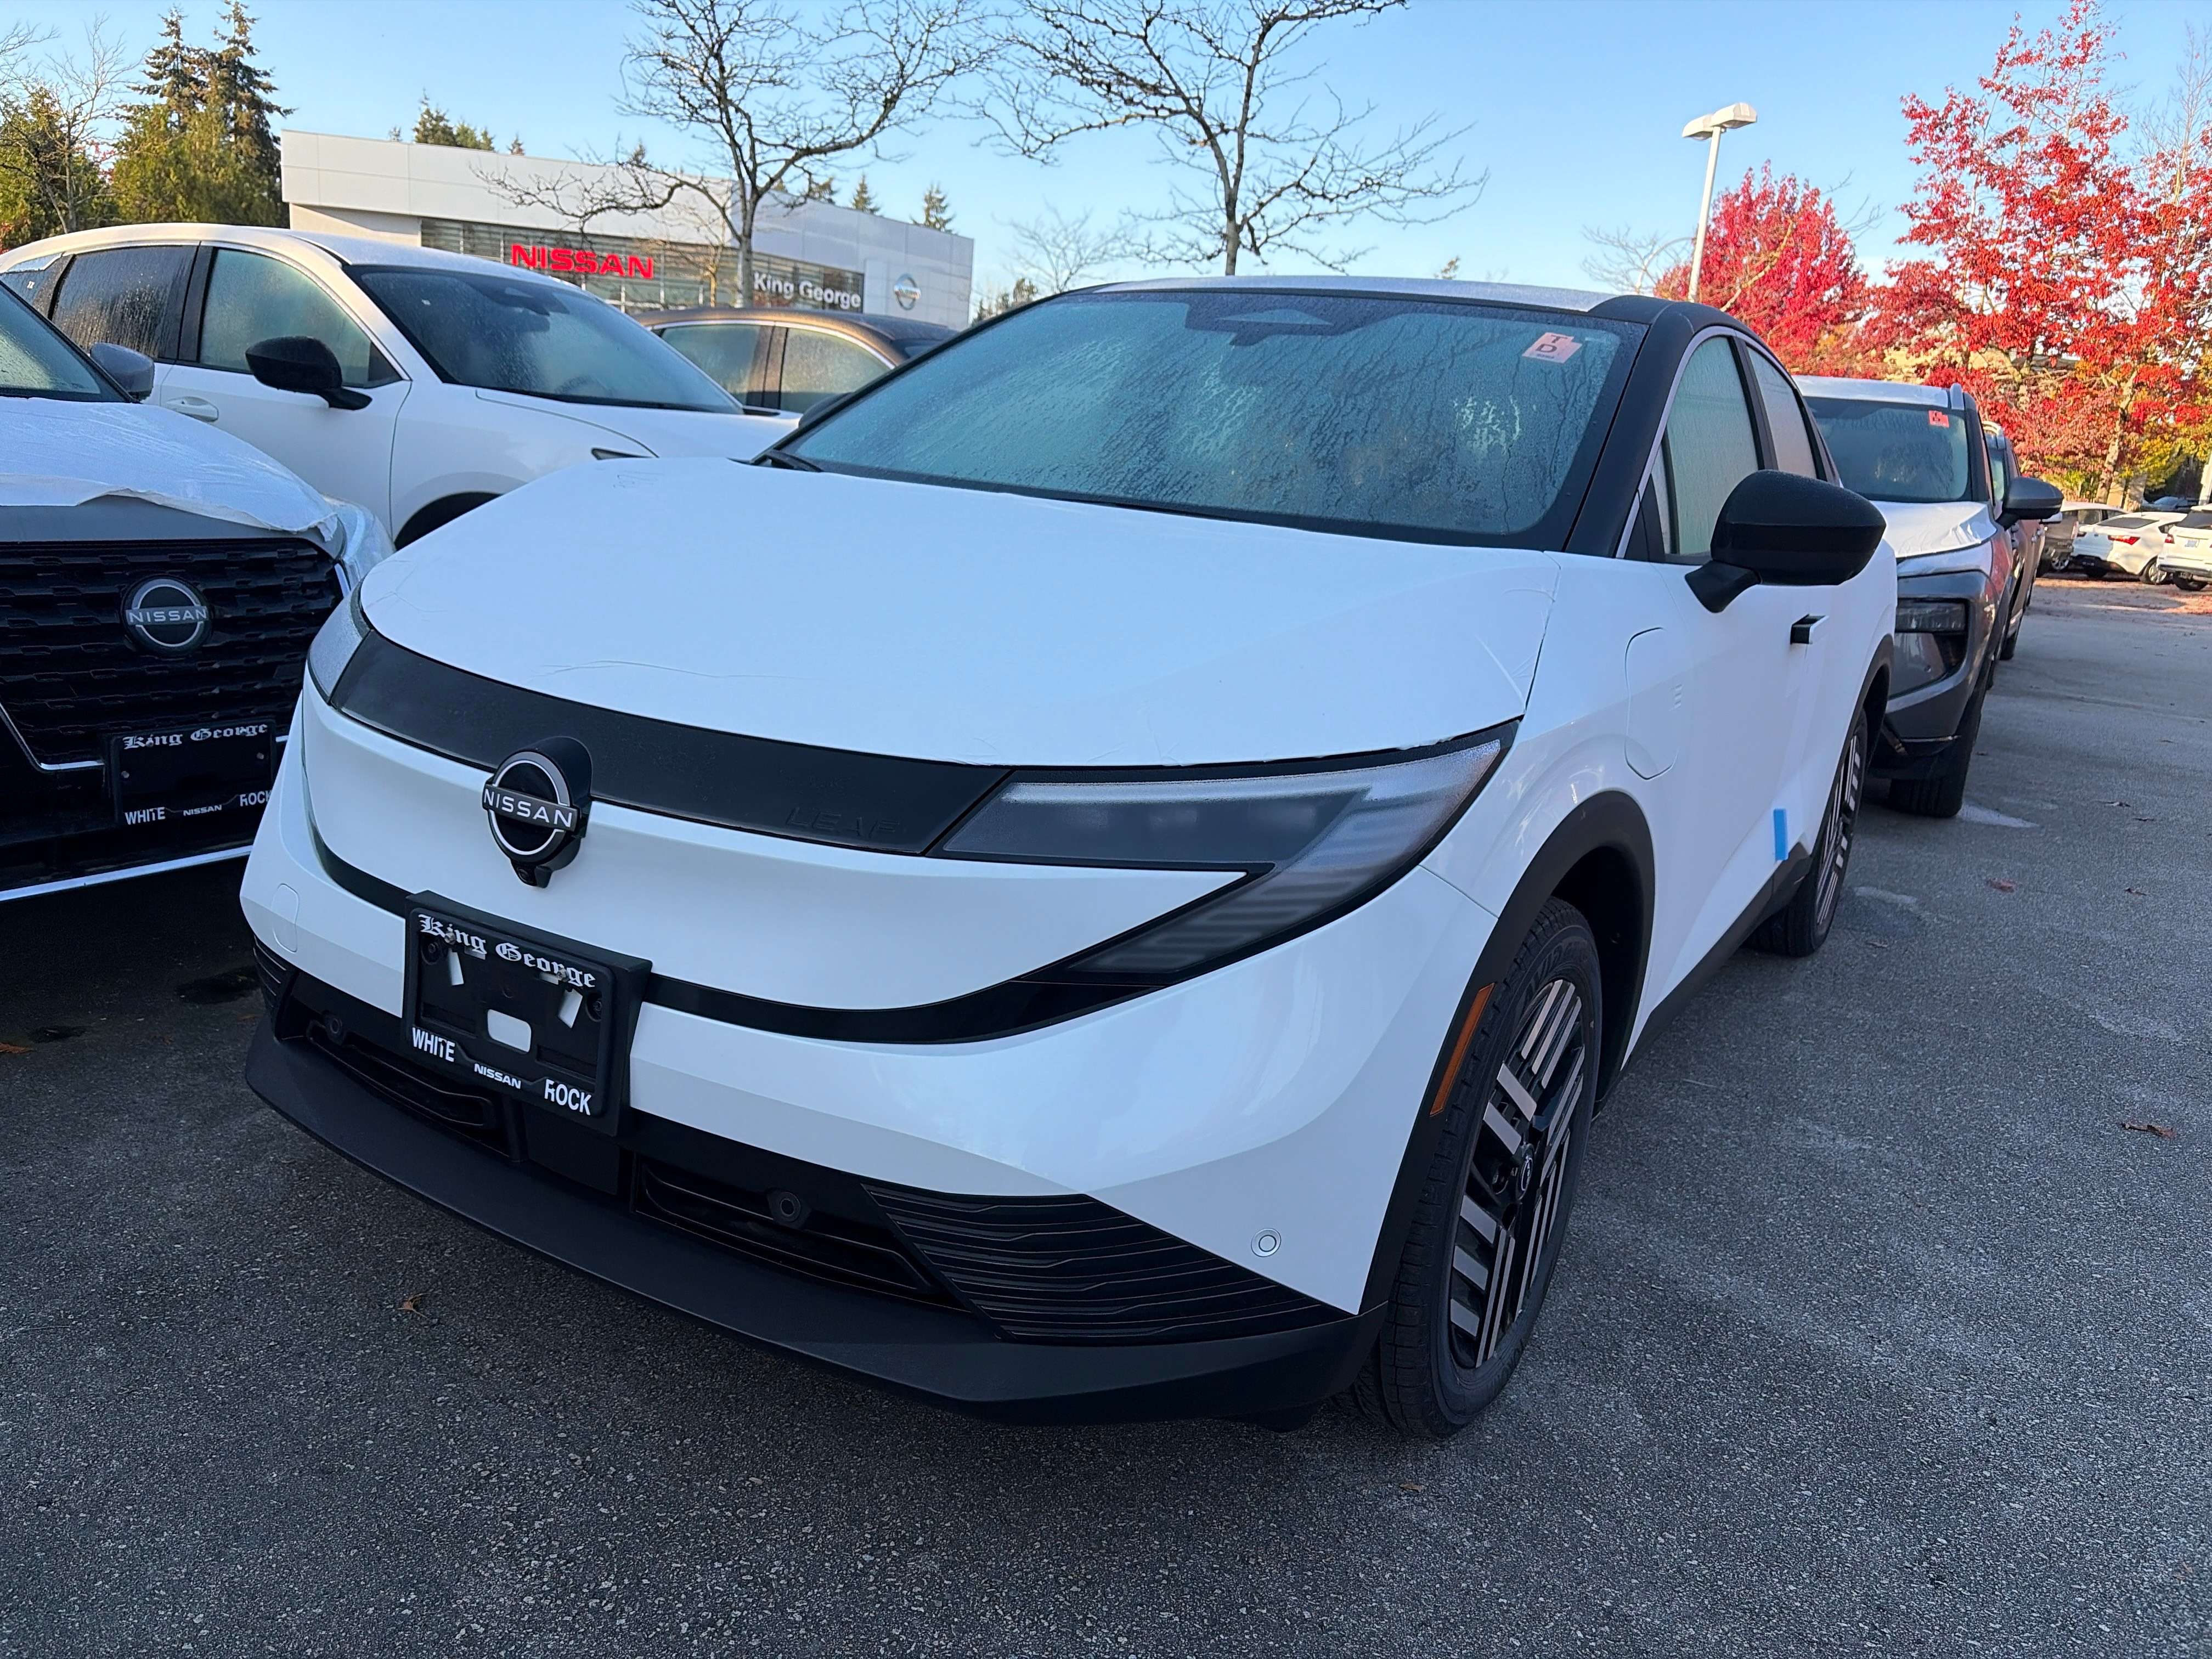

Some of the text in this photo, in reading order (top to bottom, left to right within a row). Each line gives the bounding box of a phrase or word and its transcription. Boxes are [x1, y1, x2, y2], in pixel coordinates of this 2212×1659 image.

[511, 242, 654, 280] NISSAN
[753, 271, 861, 310] King George
[128, 608, 207, 623] NISSAN
[122, 724, 268, 750] King George
[124, 806, 166, 825] WHITE
[183, 804, 222, 816] NISSAN
[483, 788, 573, 828] NISSAN
[417, 914, 596, 988] King George
[412, 1027, 592, 1116] WHITE NISSAN ROCK
